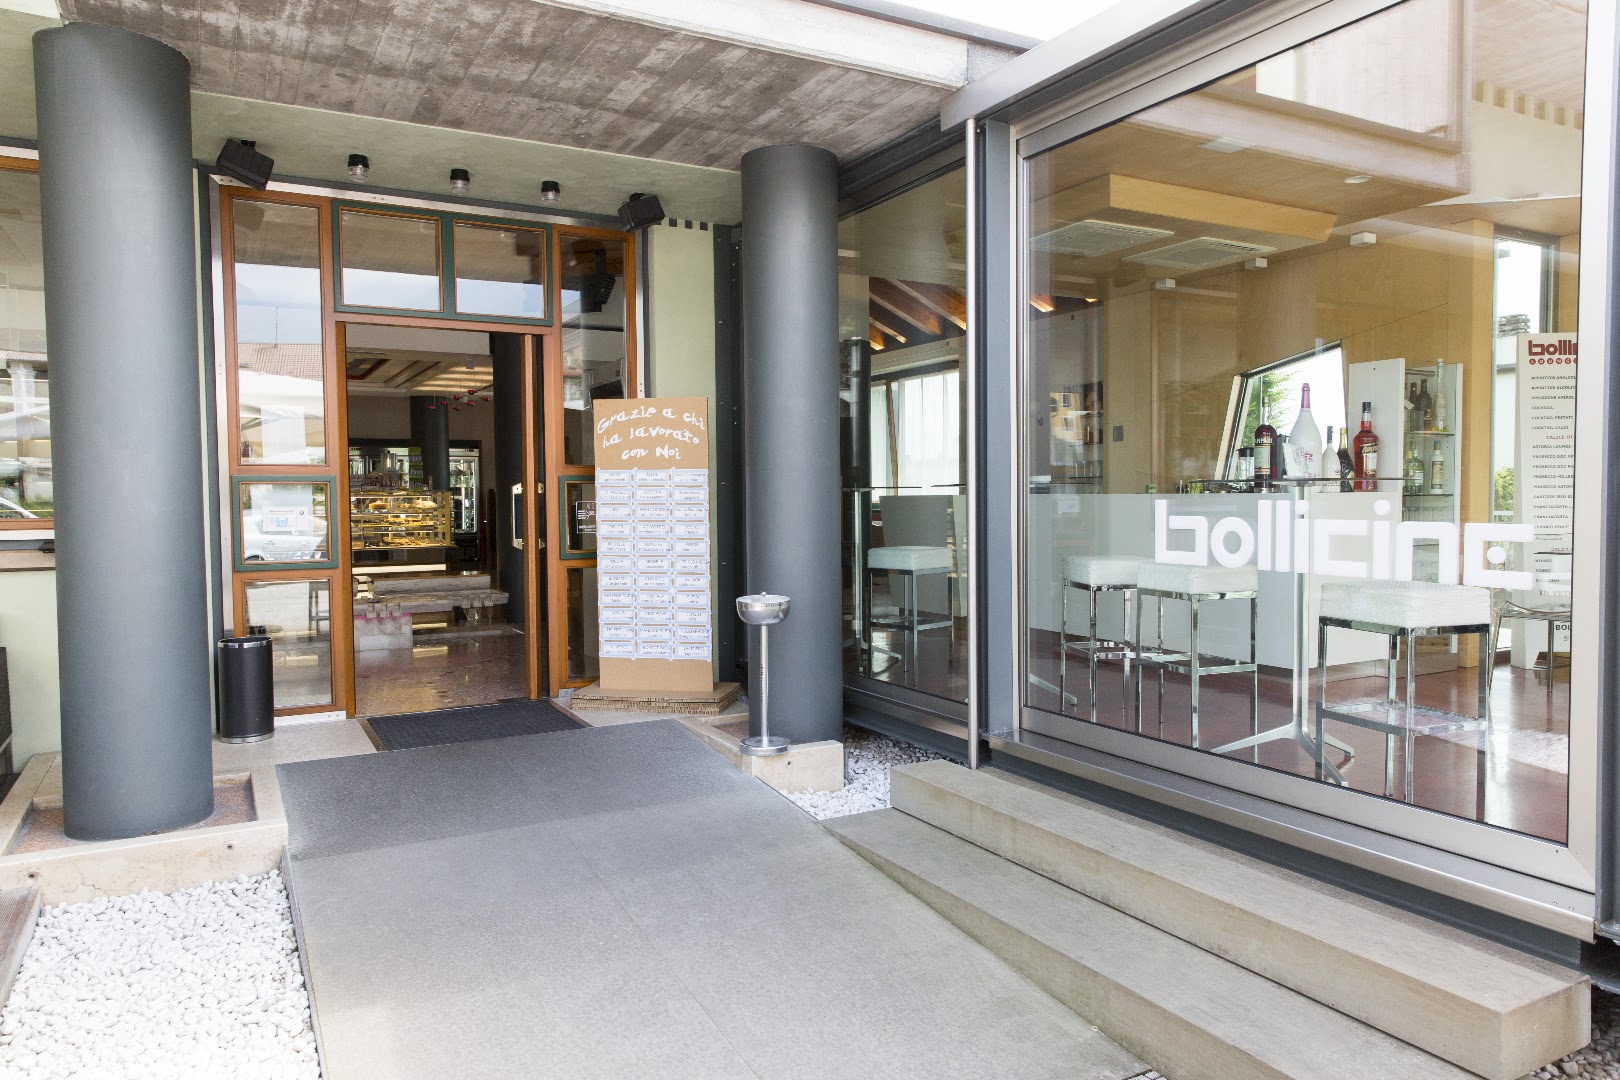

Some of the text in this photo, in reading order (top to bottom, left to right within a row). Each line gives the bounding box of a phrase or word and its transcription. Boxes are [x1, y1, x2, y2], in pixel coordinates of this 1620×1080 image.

[597, 406, 705, 433] Grazie a chi
[603, 426, 700, 449] ha lavorato
[621, 444, 681, 460] con Noi
[1155, 499, 1535, 590] bollicine
